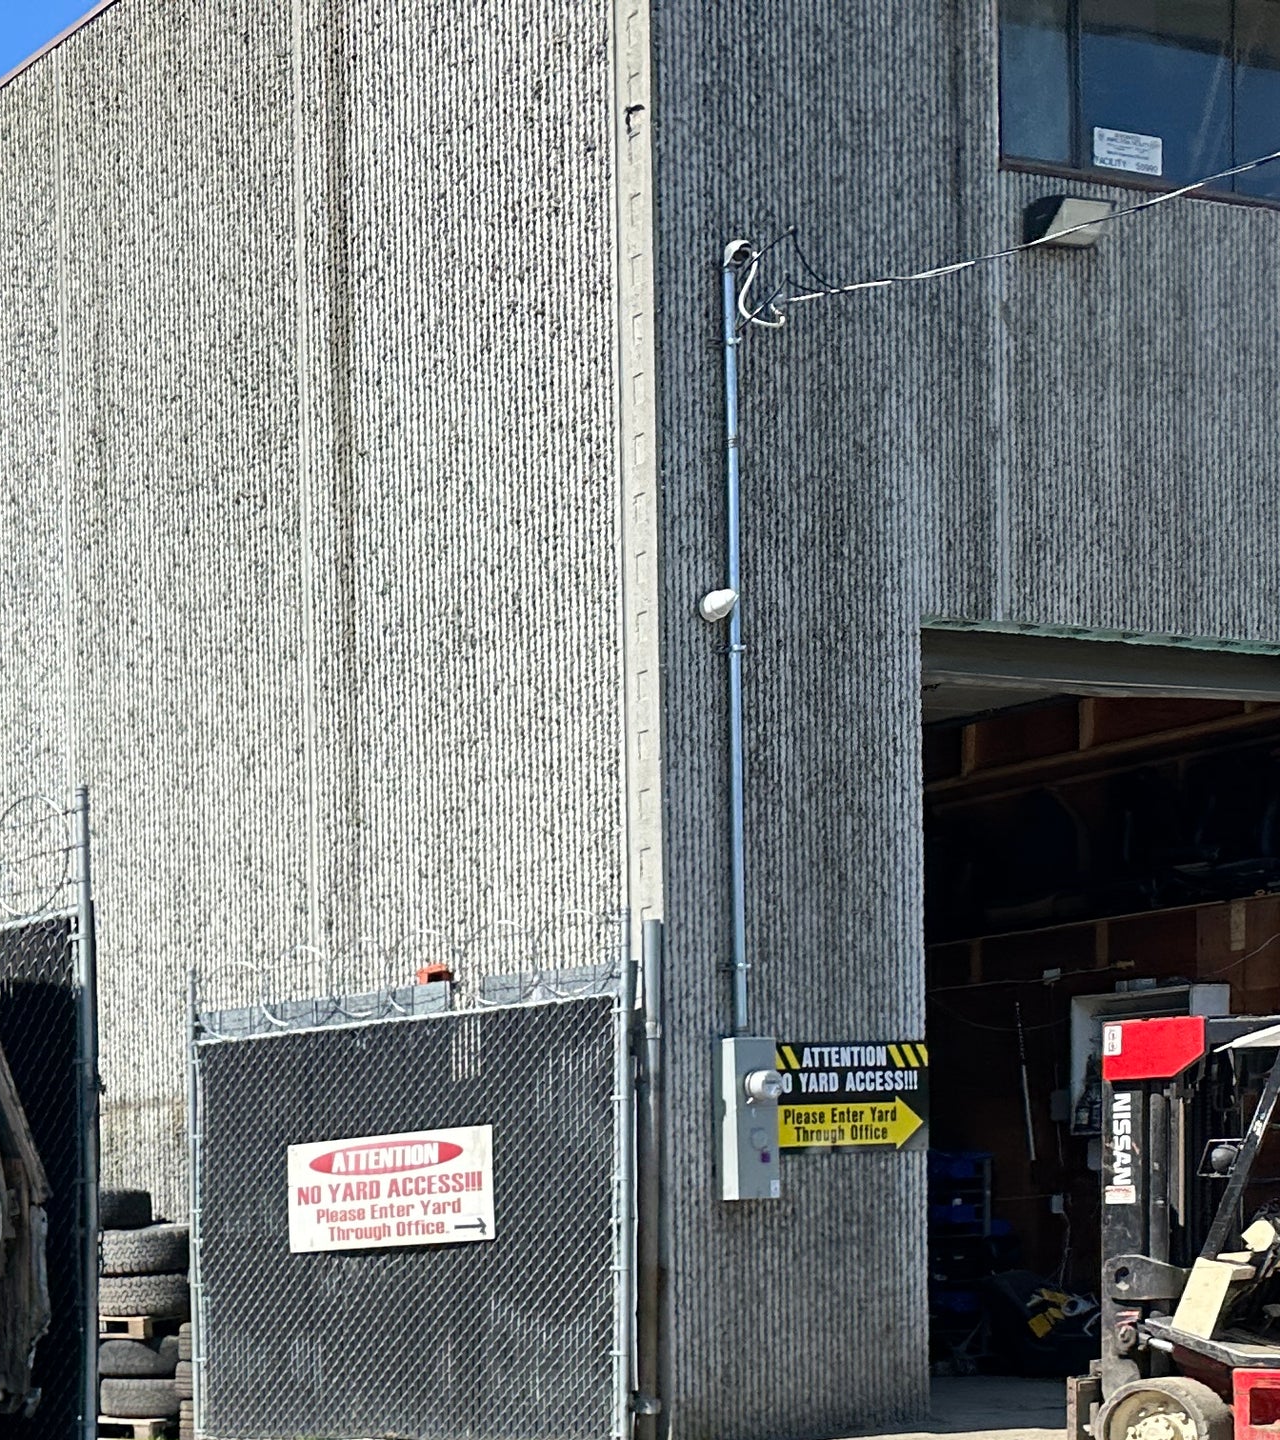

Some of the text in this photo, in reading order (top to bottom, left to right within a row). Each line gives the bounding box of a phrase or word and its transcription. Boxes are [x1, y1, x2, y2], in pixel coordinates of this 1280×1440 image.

[801, 1045, 887, 1068] ATTENTION
[798, 1072, 839, 1092] YARD
[845, 1070, 918, 1092] ACCESS!!!
[783, 1106, 897, 1125] Please Enter Yard
[794, 1124, 888, 1144] Through Office
[1112, 1092, 1132, 1186] NISSAN
[331, 1142, 439, 1174] ATTENTION
[297, 1171, 483, 1206] NO YARD ACCESS!!!
[316, 1197, 462, 1225] Please Enter Yard
[328, 1223, 391, 1242] Through
